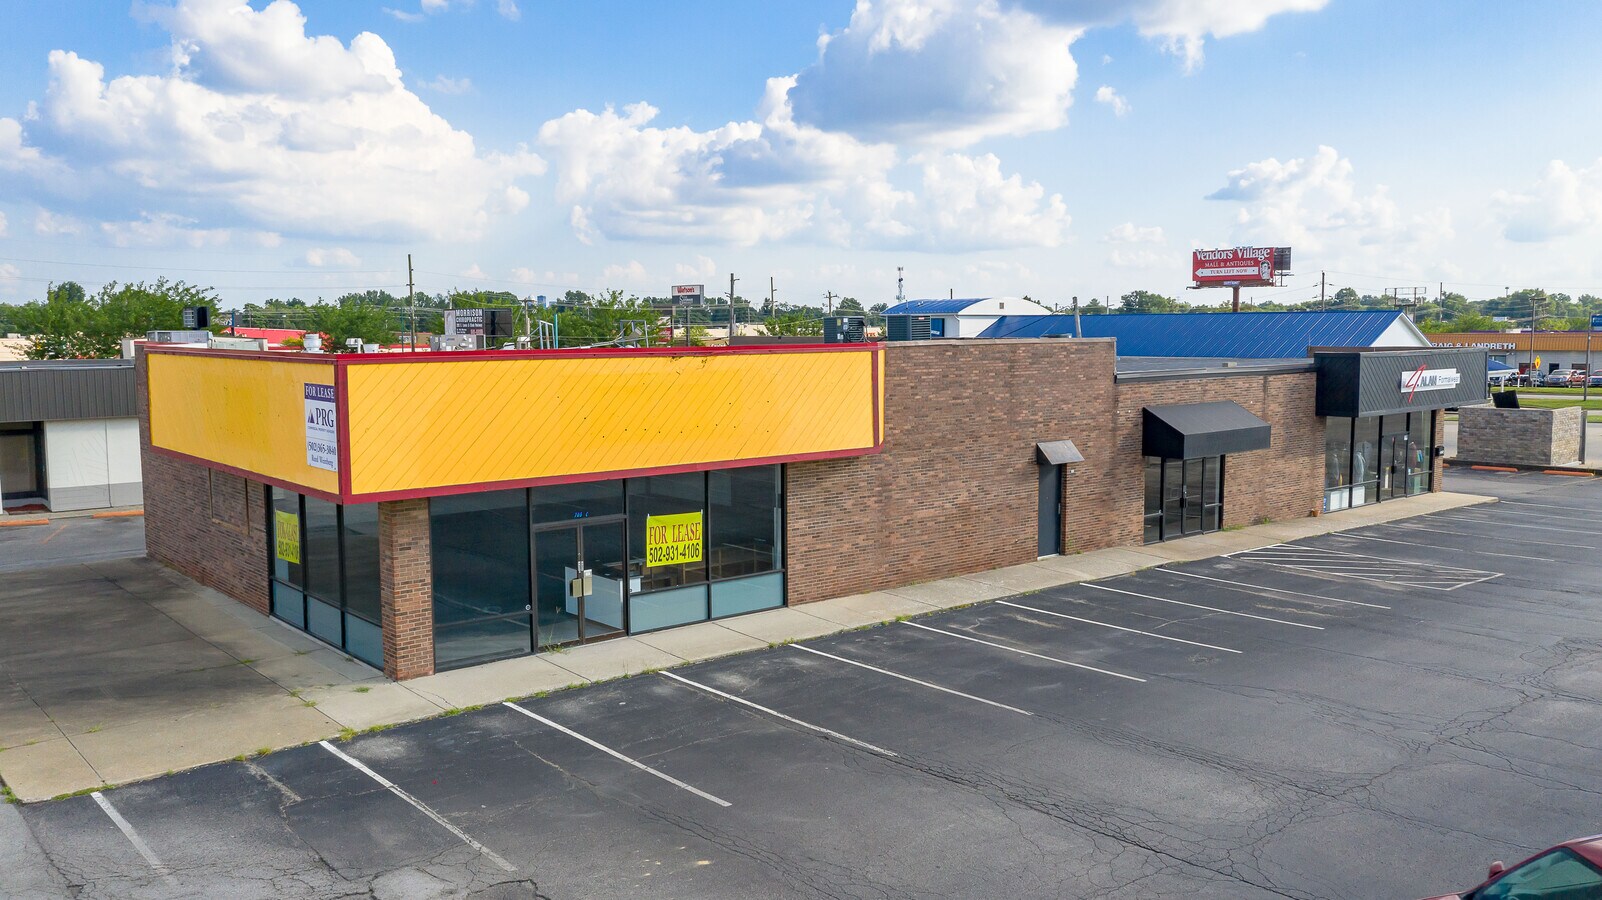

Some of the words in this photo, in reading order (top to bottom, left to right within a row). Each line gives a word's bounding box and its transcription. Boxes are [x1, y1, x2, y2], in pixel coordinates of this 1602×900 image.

[1195, 248, 1235, 260] Vendors'
[1236, 246, 1270, 261] Village
[305, 385, 316, 397] FOR
[317, 387, 335, 399] LEASE
[315, 407, 334, 428] PRG
[649, 525, 668, 545] FOR
[671, 522, 700, 543] LEASE
[649, 543, 700, 563] 502-931-4106
